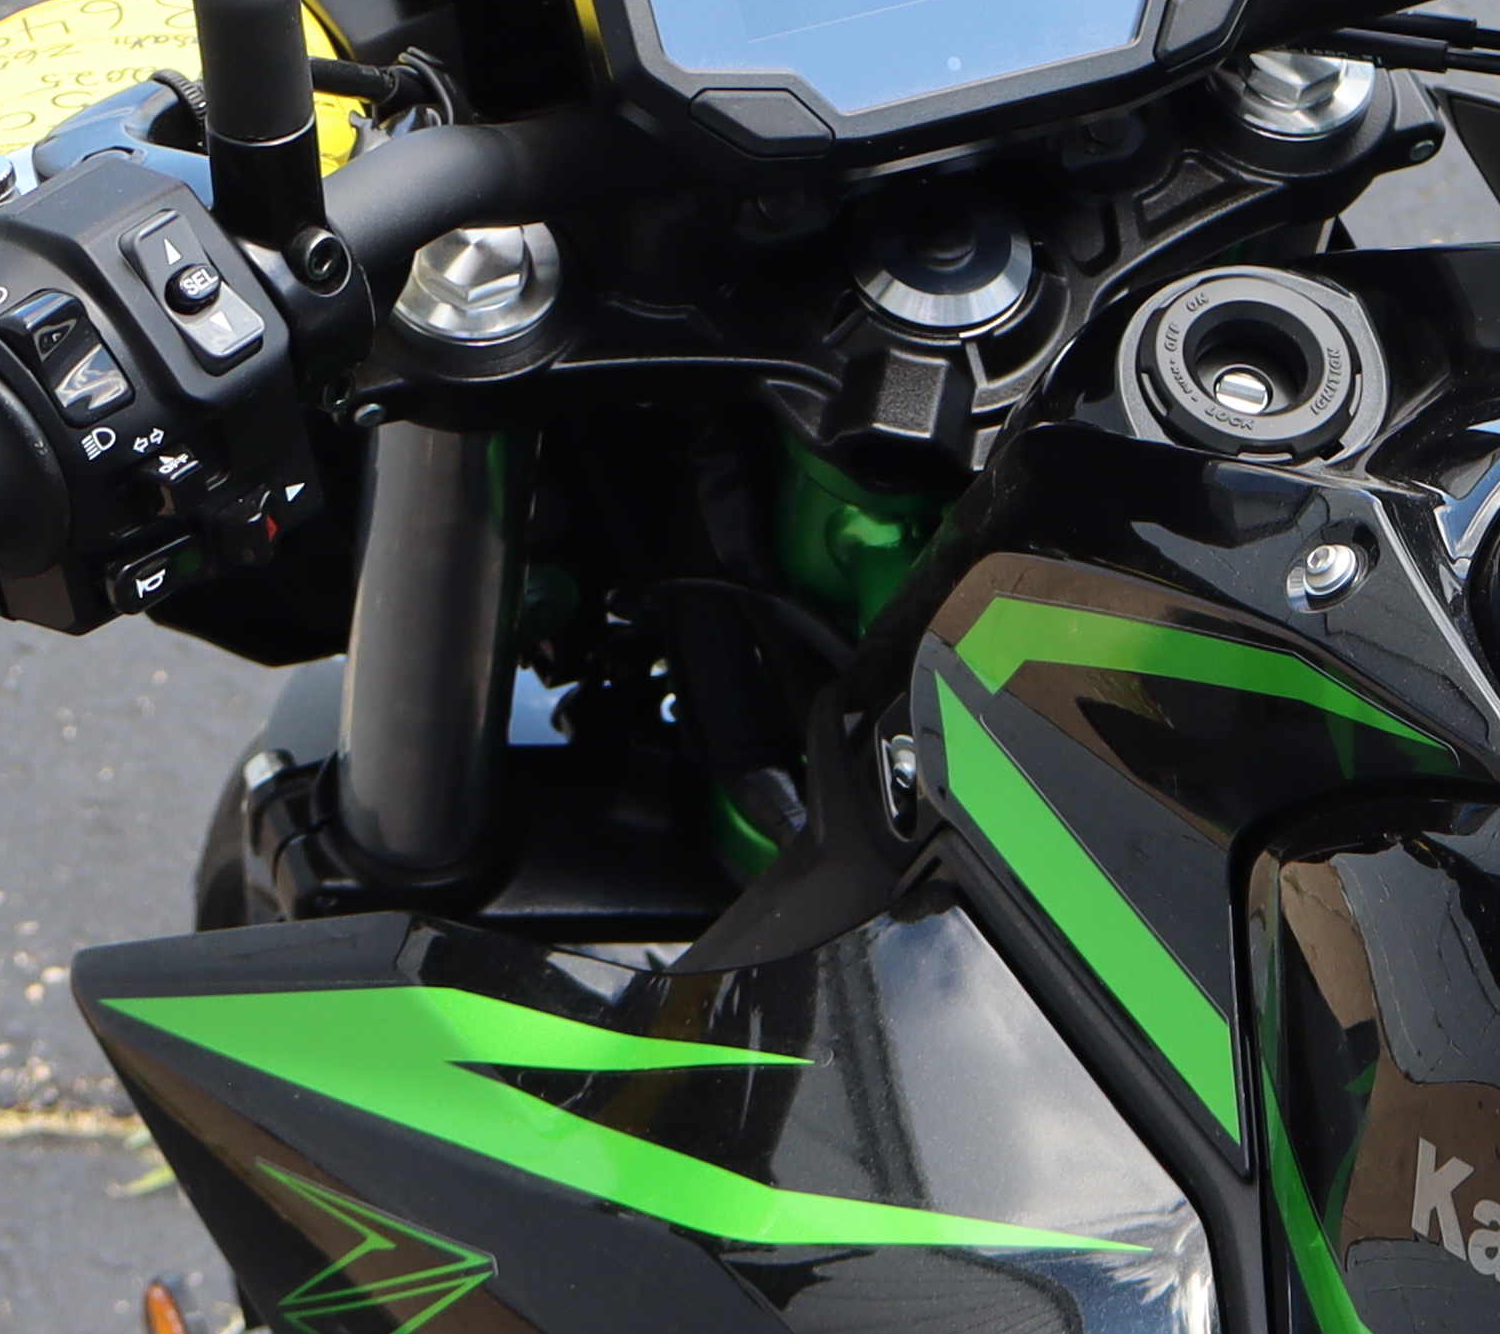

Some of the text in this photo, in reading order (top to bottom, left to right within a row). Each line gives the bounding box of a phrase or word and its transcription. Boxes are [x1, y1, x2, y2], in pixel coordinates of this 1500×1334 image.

[183, 268, 219, 296] SEL
[1186, 293, 1210, 313] ON
[1164, 322, 1181, 352] OFF
[1309, 346, 1342, 416] IGNITION
[1203, 404, 1255, 430] LOCK
